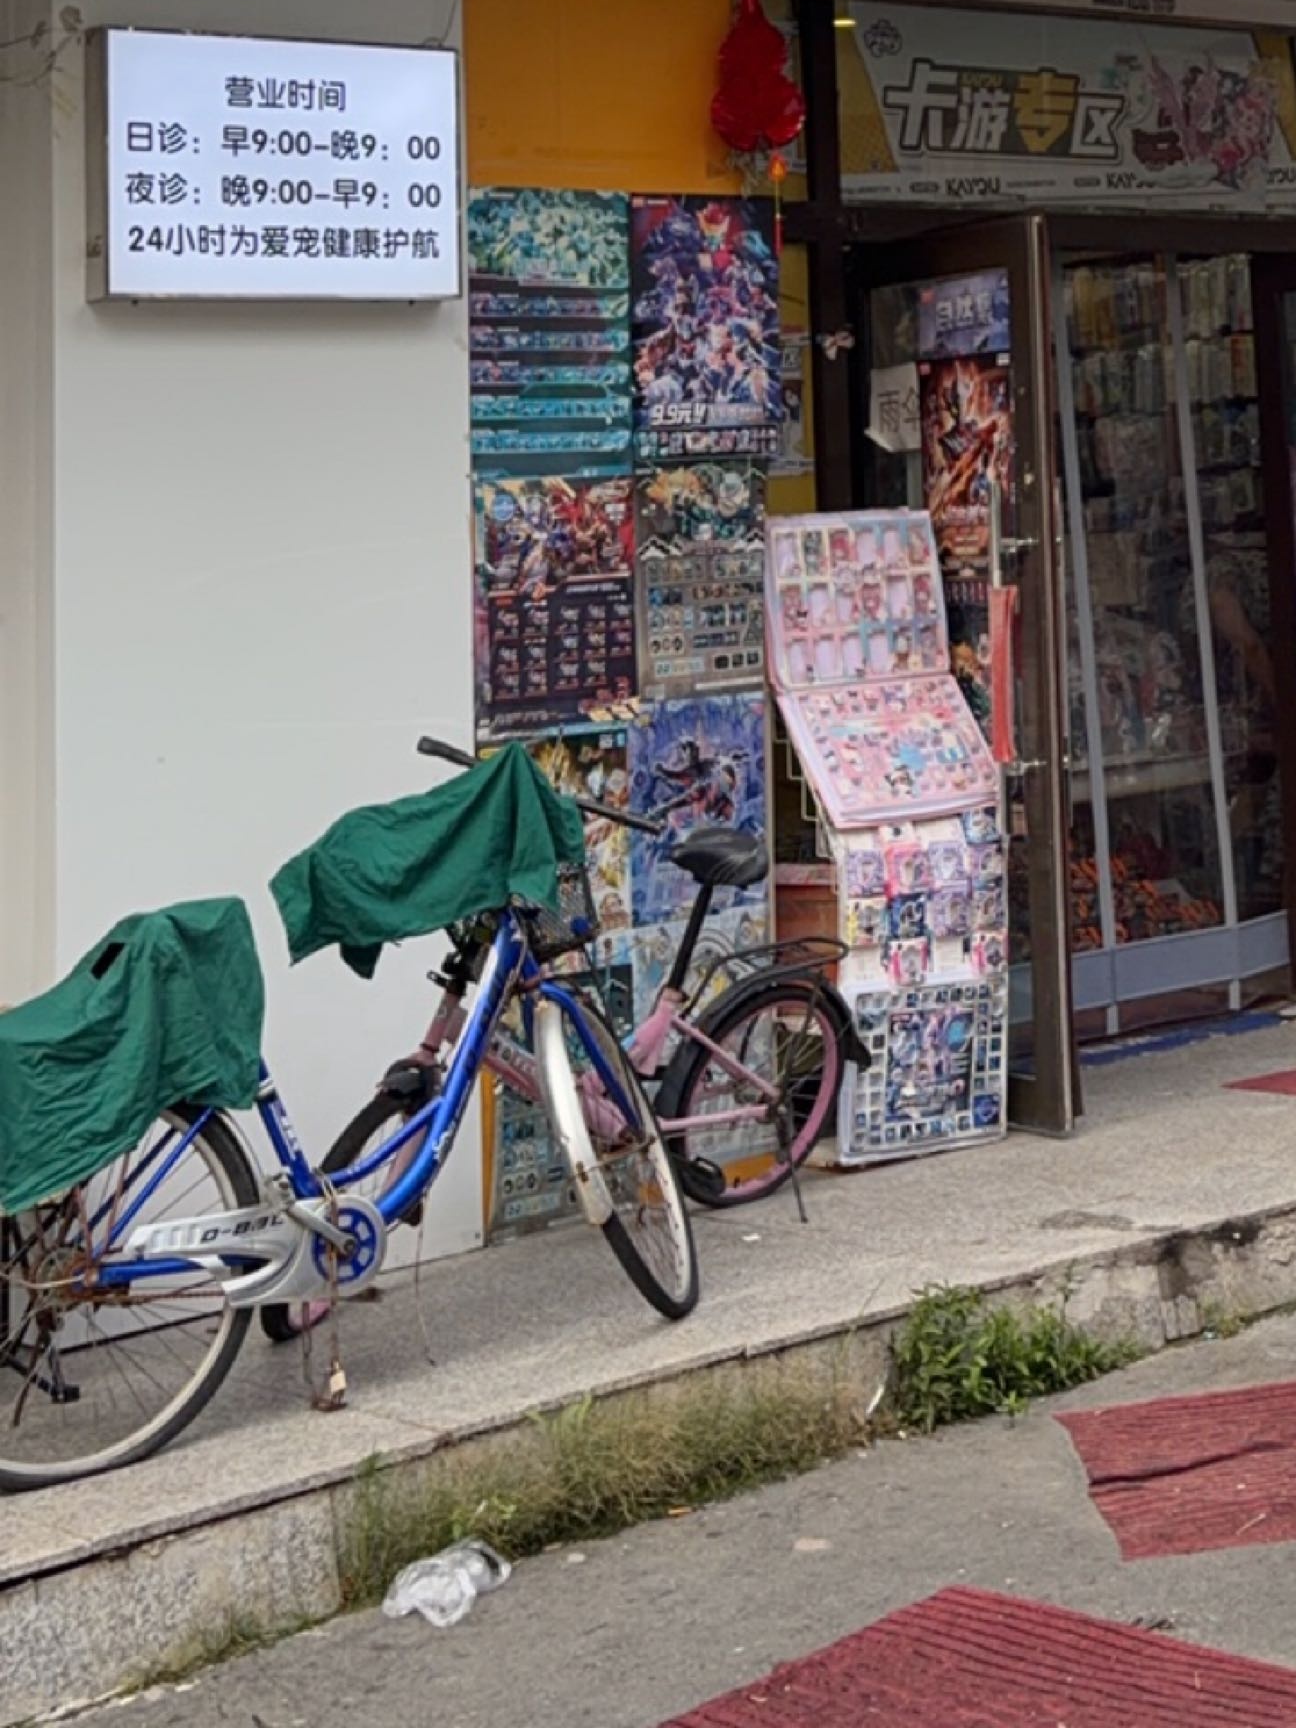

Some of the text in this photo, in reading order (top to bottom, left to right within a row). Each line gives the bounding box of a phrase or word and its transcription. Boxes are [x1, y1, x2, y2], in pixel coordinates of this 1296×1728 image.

[225, 76, 347, 113] 营业时间
[883, 58, 1124, 160] 卡游专区
[128, 224, 441, 261] 24小时为爱宠健康护航
[877, 386, 921, 433] 雨伞
